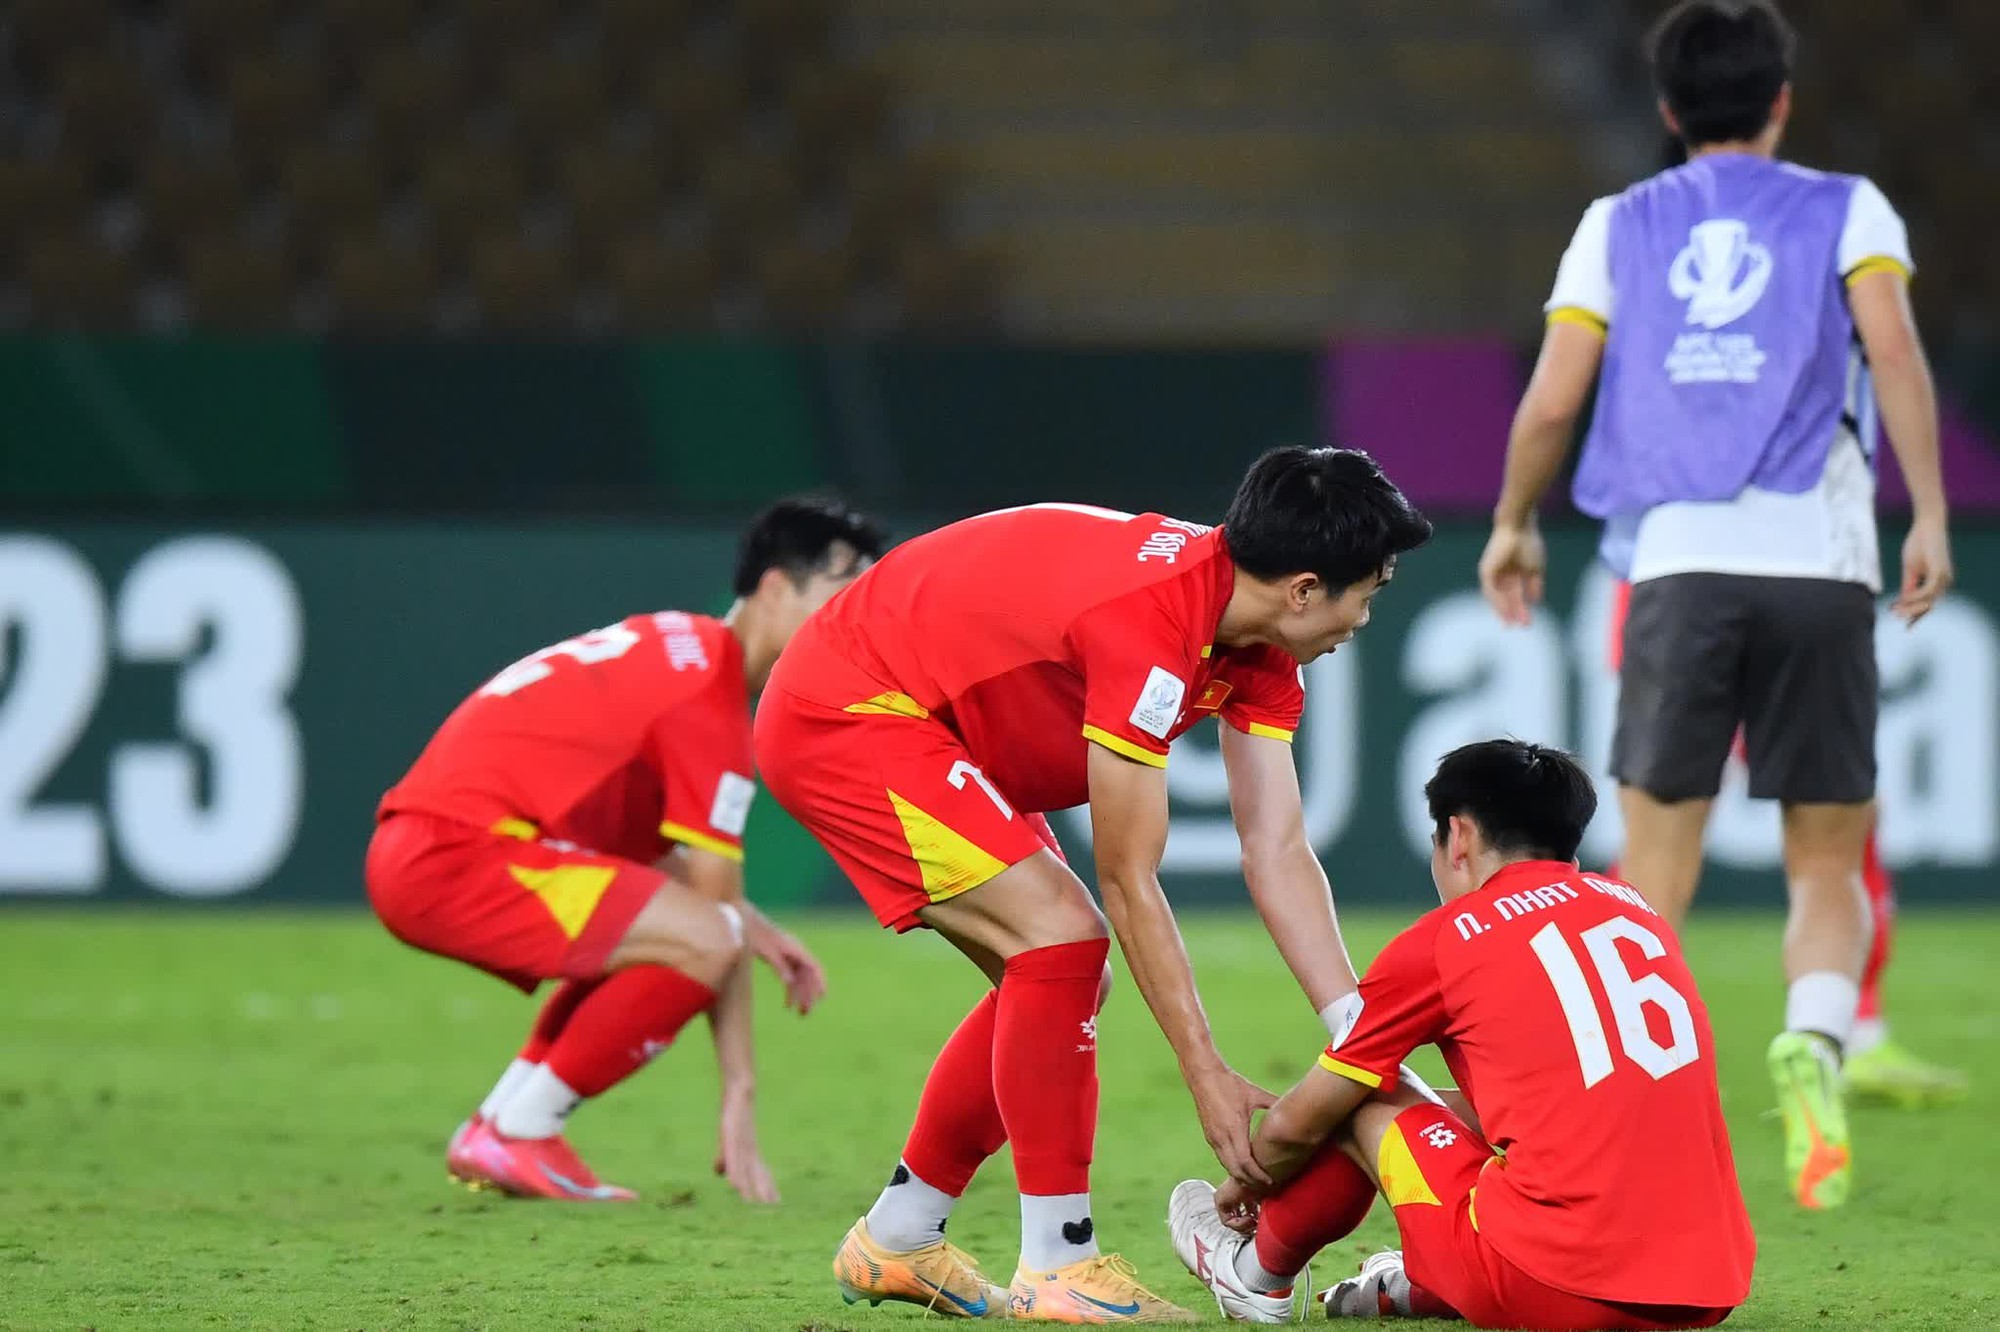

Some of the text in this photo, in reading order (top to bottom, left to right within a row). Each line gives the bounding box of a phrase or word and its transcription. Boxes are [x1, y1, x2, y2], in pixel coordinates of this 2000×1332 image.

[946, 760, 1013, 821] 7
[1493, 880, 1579, 921] NHAT
[1529, 915, 1700, 1090] 16
